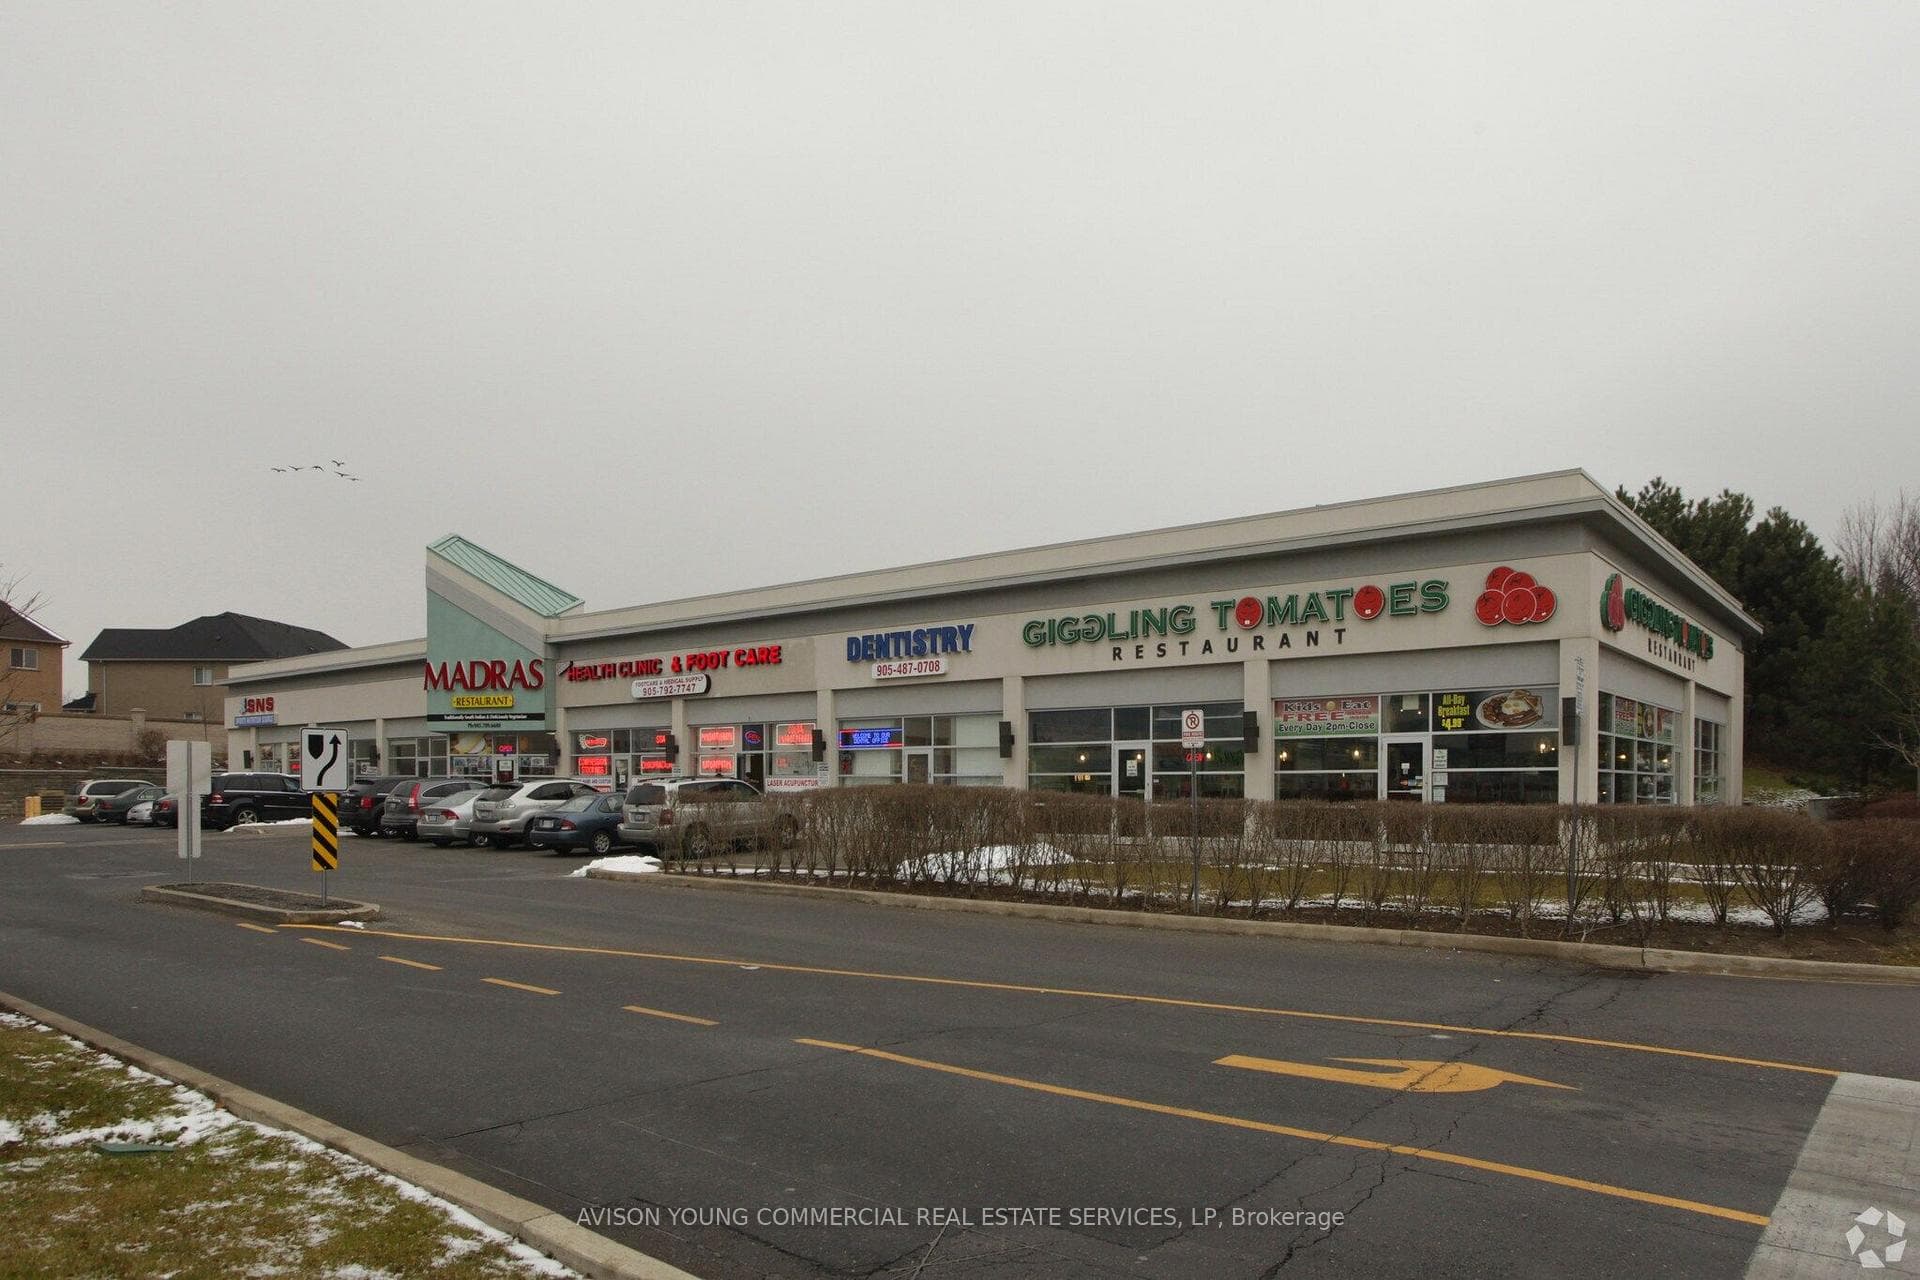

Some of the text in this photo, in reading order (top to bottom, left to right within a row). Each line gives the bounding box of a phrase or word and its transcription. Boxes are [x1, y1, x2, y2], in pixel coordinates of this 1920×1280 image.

[847, 623, 975, 663] DENTISTRY
[1112, 628, 1347, 661] RESTAURANT
[1648, 638, 1696, 672] RESTAURANT
[568, 646, 782, 682] HEALTH CLINIC & FOOT CARE
[876, 660, 941, 677] 905-487-0708
[424, 658, 545, 691] MADRAS
[642, 683, 696, 696] 905-792-7747
[247, 696, 274, 713] SNS
[456, 696, 509, 706] RESTAURANT
[1284, 700, 1371, 712] Kids Eat
[1282, 711, 1345, 722] FREE
[1279, 721, 1375, 732] Every Day 2pm-Close
[1186, 752, 1204, 762] OEN
